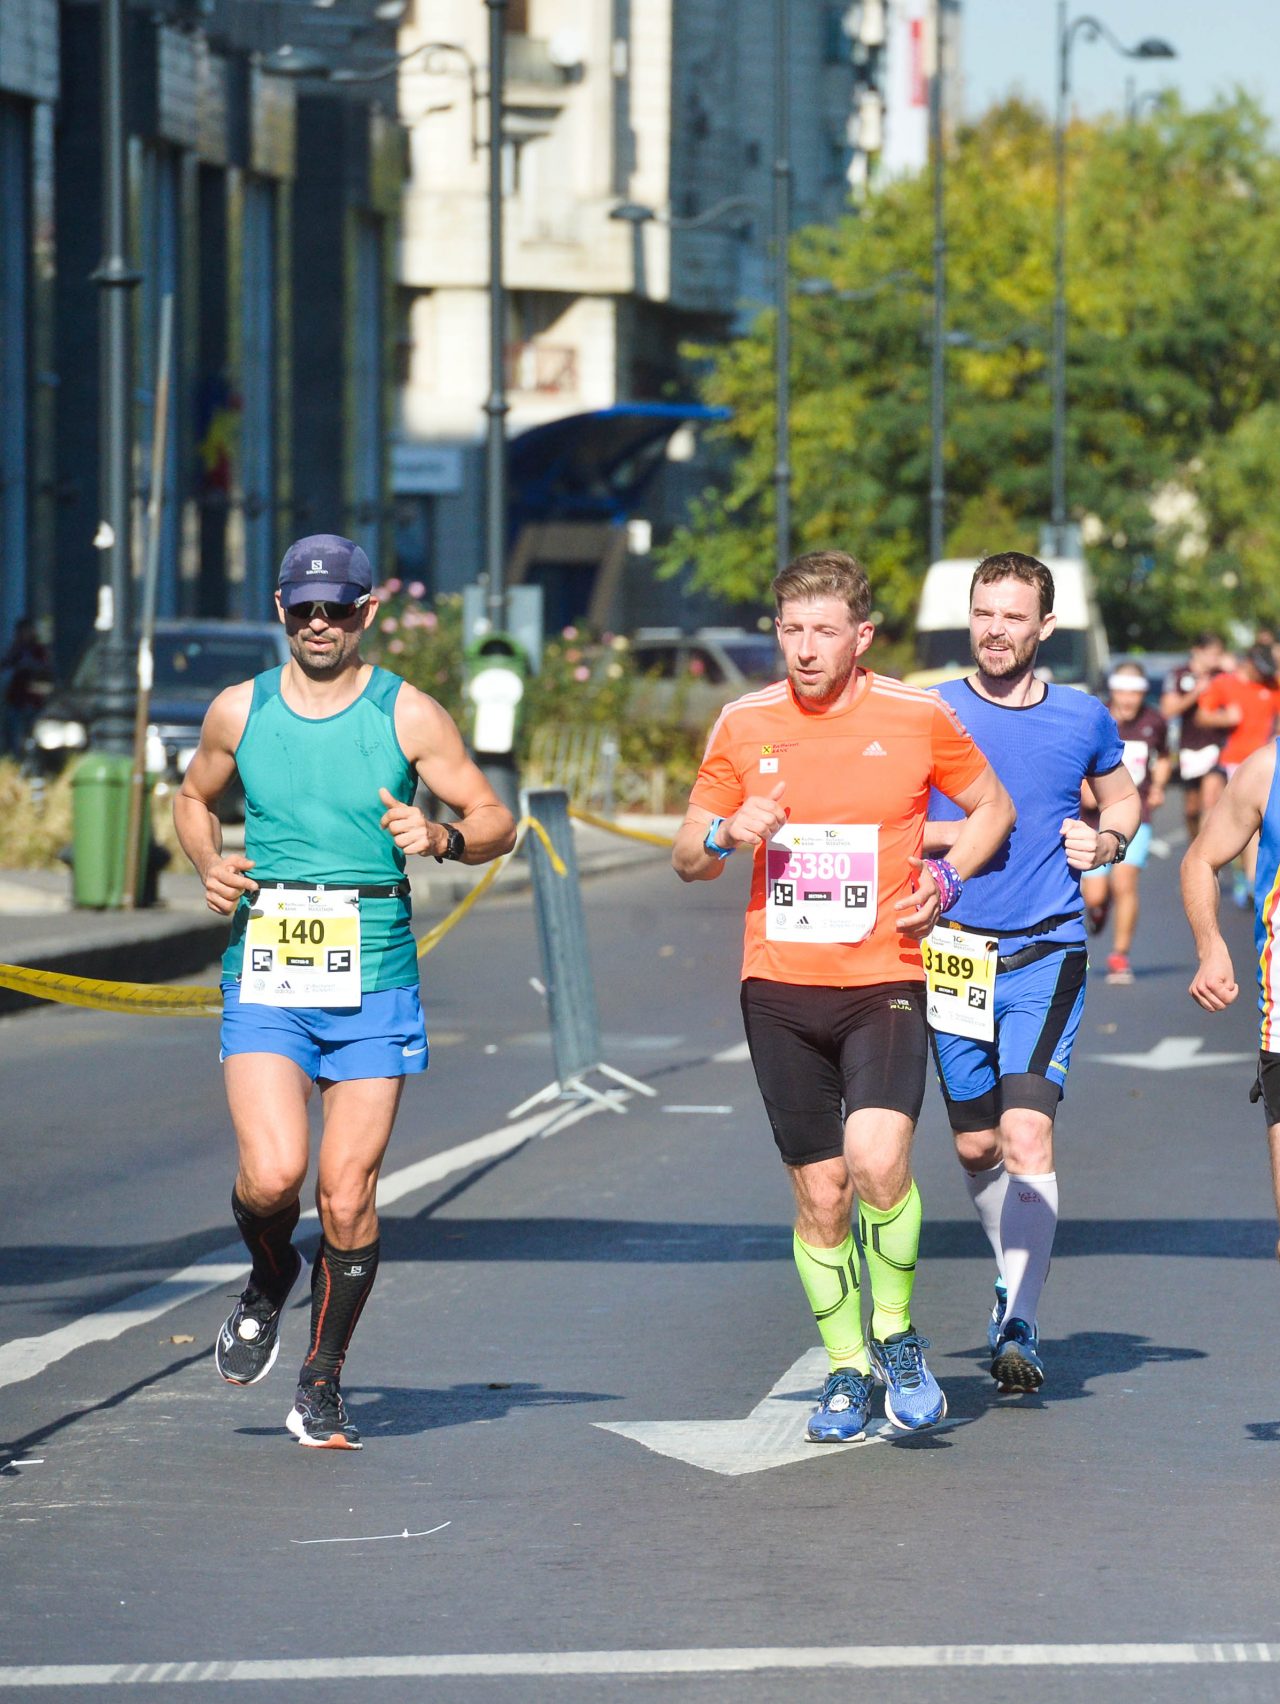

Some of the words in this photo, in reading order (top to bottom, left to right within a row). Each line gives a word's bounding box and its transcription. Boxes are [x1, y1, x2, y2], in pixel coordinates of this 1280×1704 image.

[788, 853, 851, 880] 5380
[278, 919, 325, 944] 140
[925, 947, 974, 979] 3189
